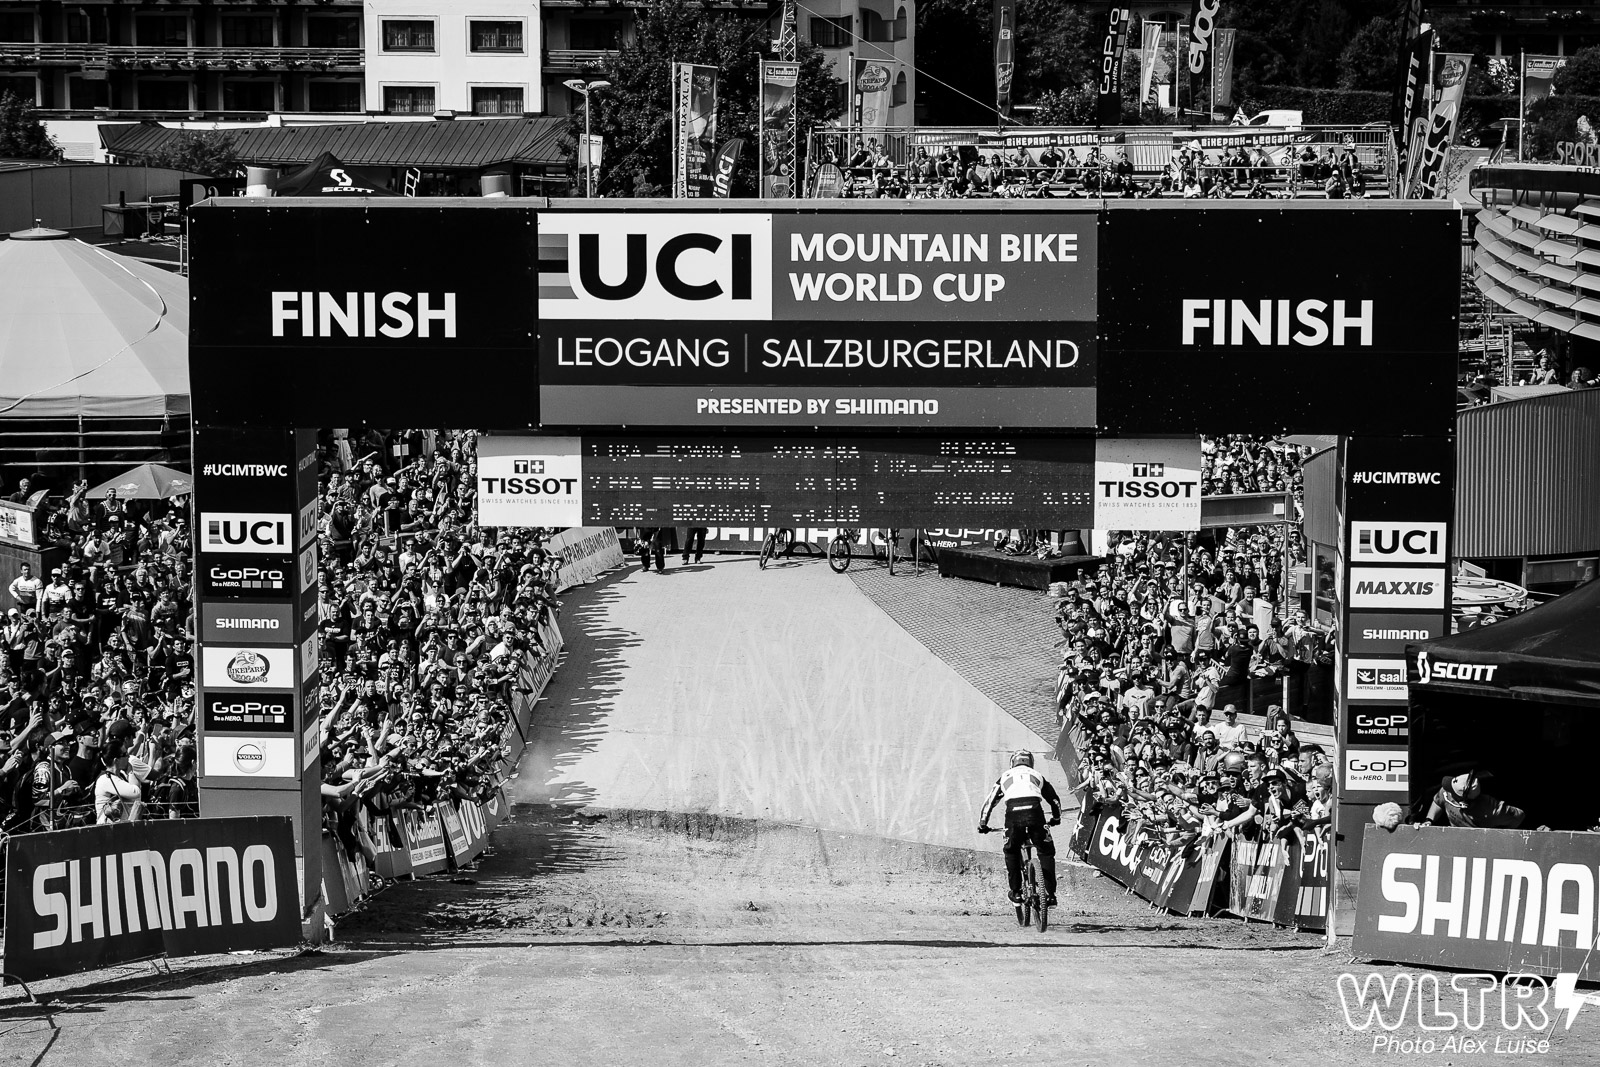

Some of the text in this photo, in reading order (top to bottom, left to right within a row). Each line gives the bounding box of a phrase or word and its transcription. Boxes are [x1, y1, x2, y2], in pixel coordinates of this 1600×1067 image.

[1099, 7, 1120, 95] GoPro
[321, 186, 375, 194] SCOTT
[789, 233, 1079, 263] MOUNTAIN BIKE
[579, 232, 752, 300] UCI
[789, 272, 1006, 302] WORLD CUP
[271, 291, 457, 339] FINISH
[1180, 298, 1375, 347] FINISH
[557, 337, 1080, 370] LEOGANG SALZBURGERLAND
[696, 398, 939, 415] PRESENTED BY SHIMANO
[203, 463, 288, 477] #UCIMTBWC
[1352, 471, 1441, 485] #UCIMTBWC
[481, 477, 578, 495] TISSOT
[1098, 481, 1197, 498] TISSOT
[223, 521, 284, 545] UCI
[1374, 529, 1439, 555] UCI
[937, 540, 958, 548] HERO
[210, 567, 284, 581] GoPro
[1355, 581, 1434, 596] MAXXIS
[215, 618, 280, 629] SHIMANO
[1362, 629, 1430, 640] SHIMANO
[1431, 662, 1498, 682] SCOTT
[212, 702, 286, 715] GoPro
[33, 844, 278, 950] SHIMANO
[1377, 852, 1600, 950] SHIMA
